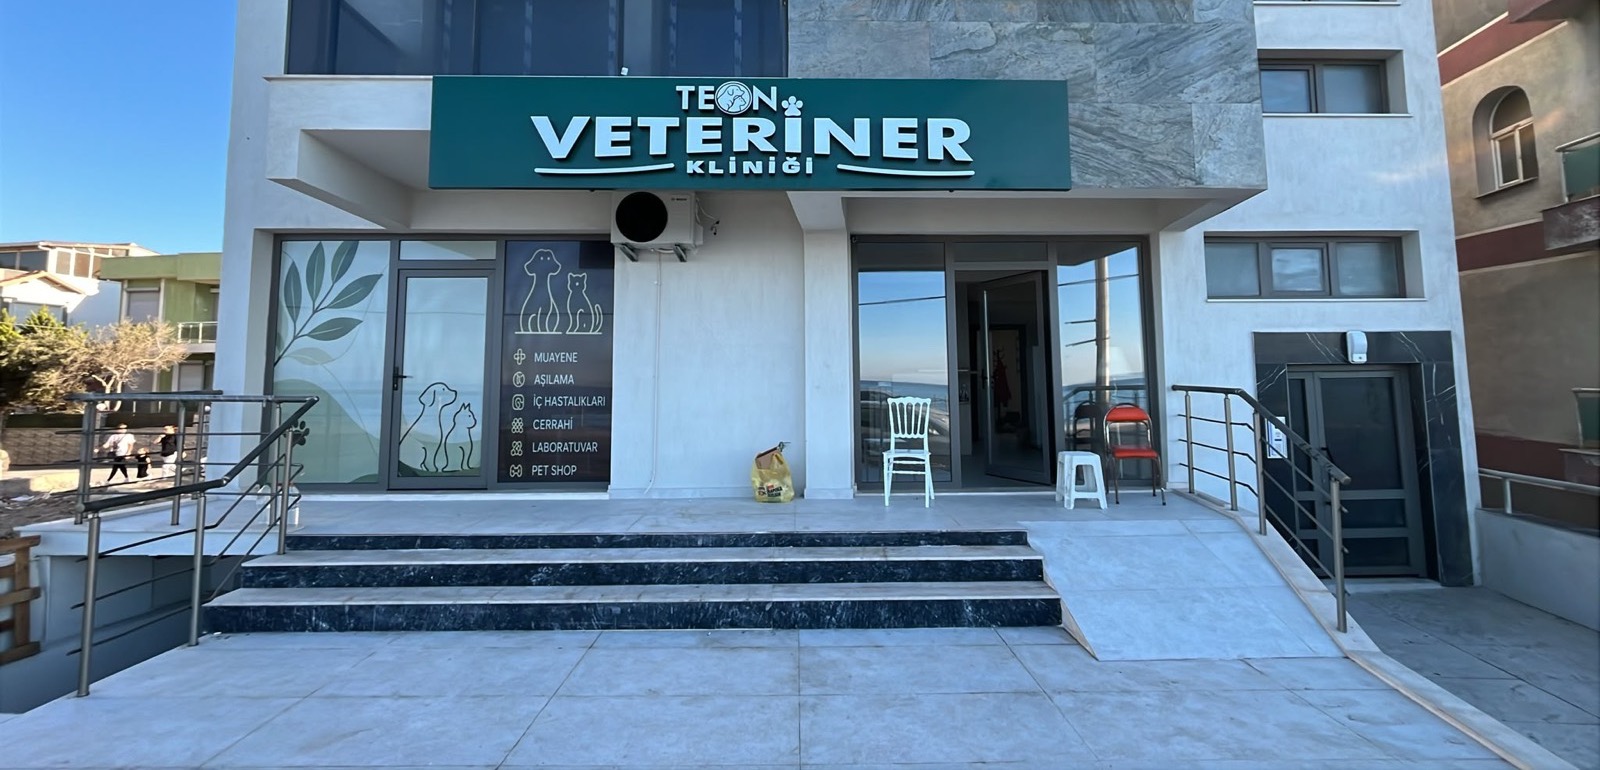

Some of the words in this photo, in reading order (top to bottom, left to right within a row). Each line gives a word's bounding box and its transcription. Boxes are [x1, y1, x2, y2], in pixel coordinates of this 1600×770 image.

[676, 81, 777, 115] TEON
[530, 97, 973, 162] VETERİNER
[686, 156, 814, 175] KLİNİĞİ
[534, 352, 577, 363] MUAYENE
[534, 374, 574, 387] AŞILAMA
[533, 394, 542, 409] İÇ
[545, 396, 606, 406] HASTALIKLARI
[533, 417, 573, 430] CERRAHİ
[532, 442, 598, 453] LABORATUVAR
[532, 465, 549, 476] PET
[551, 465, 577, 476] SHOP
